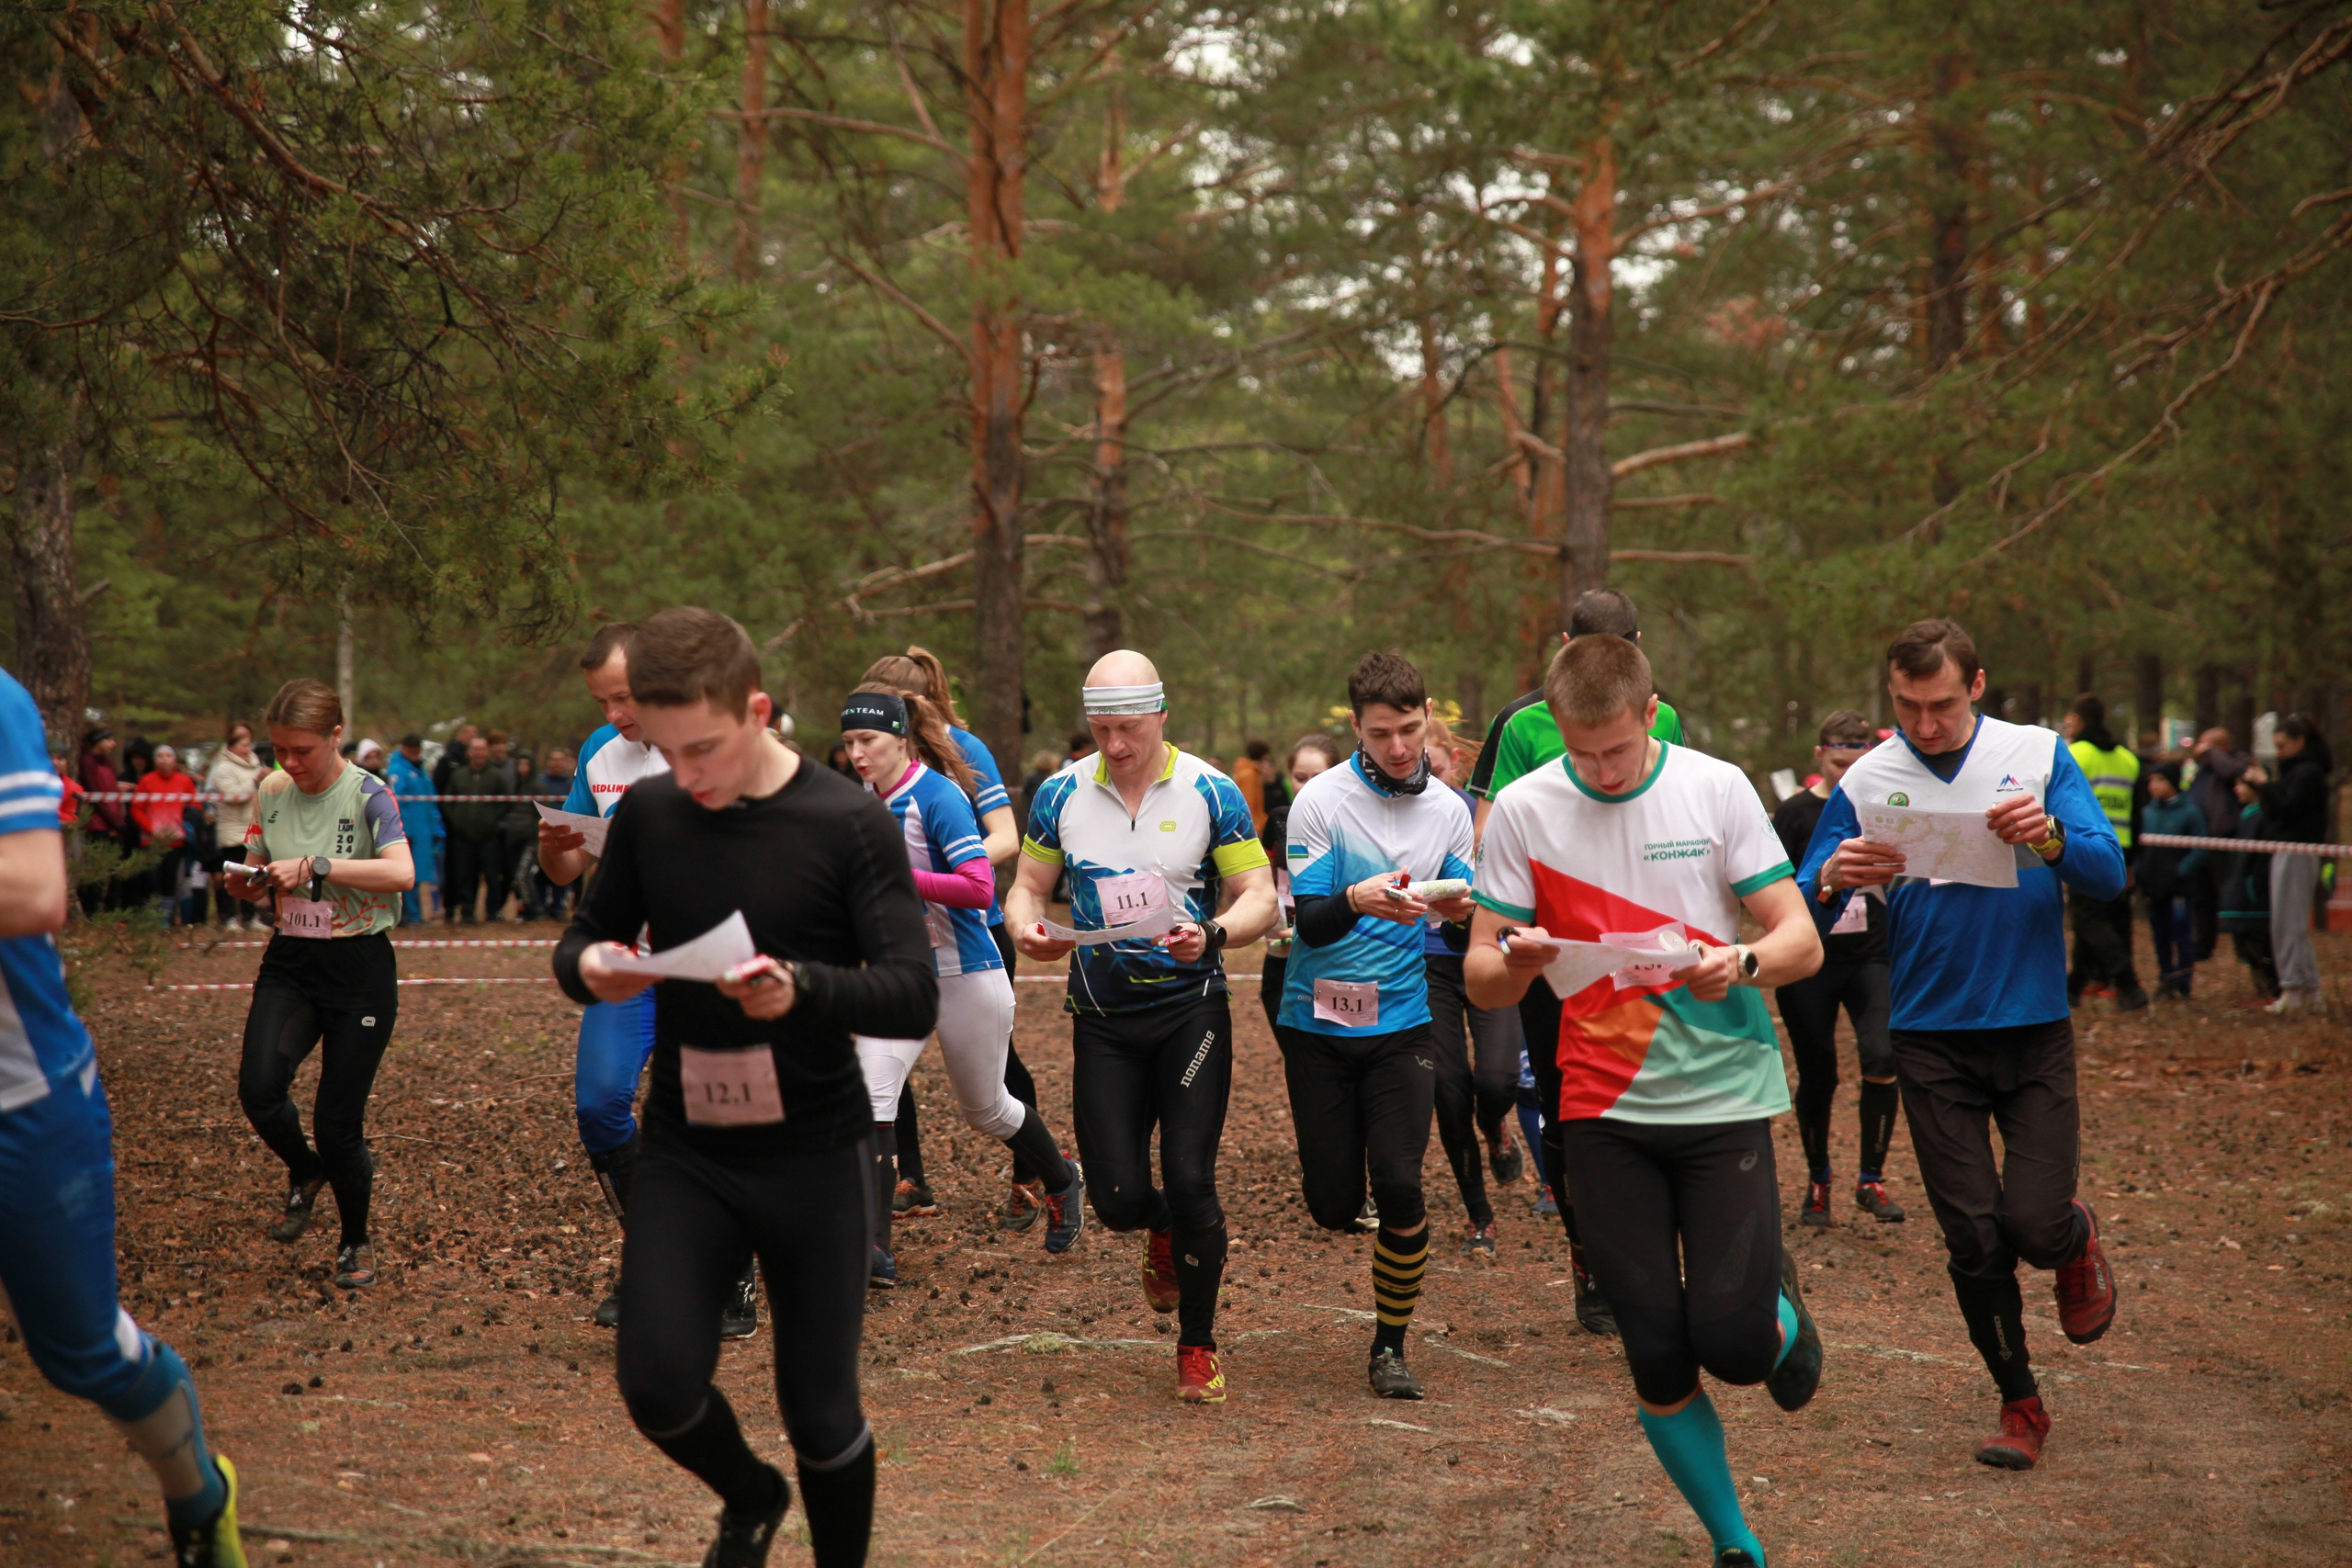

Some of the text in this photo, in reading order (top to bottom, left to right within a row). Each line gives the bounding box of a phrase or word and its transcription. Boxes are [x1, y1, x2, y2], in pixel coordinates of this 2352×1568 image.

[841, 707, 884, 716] ENTEAM
[1645, 840, 1674, 850] ГОРНЫЙ
[1644, 847, 1711, 861] «КОНЖАК»
[1116, 891, 1148, 909] 11.1
[289, 912, 320, 928] 101.1
[1331, 997, 1363, 1012] 13.1
[1181, 1030, 1215, 1088] noname
[704, 1082, 752, 1103] 12.1
